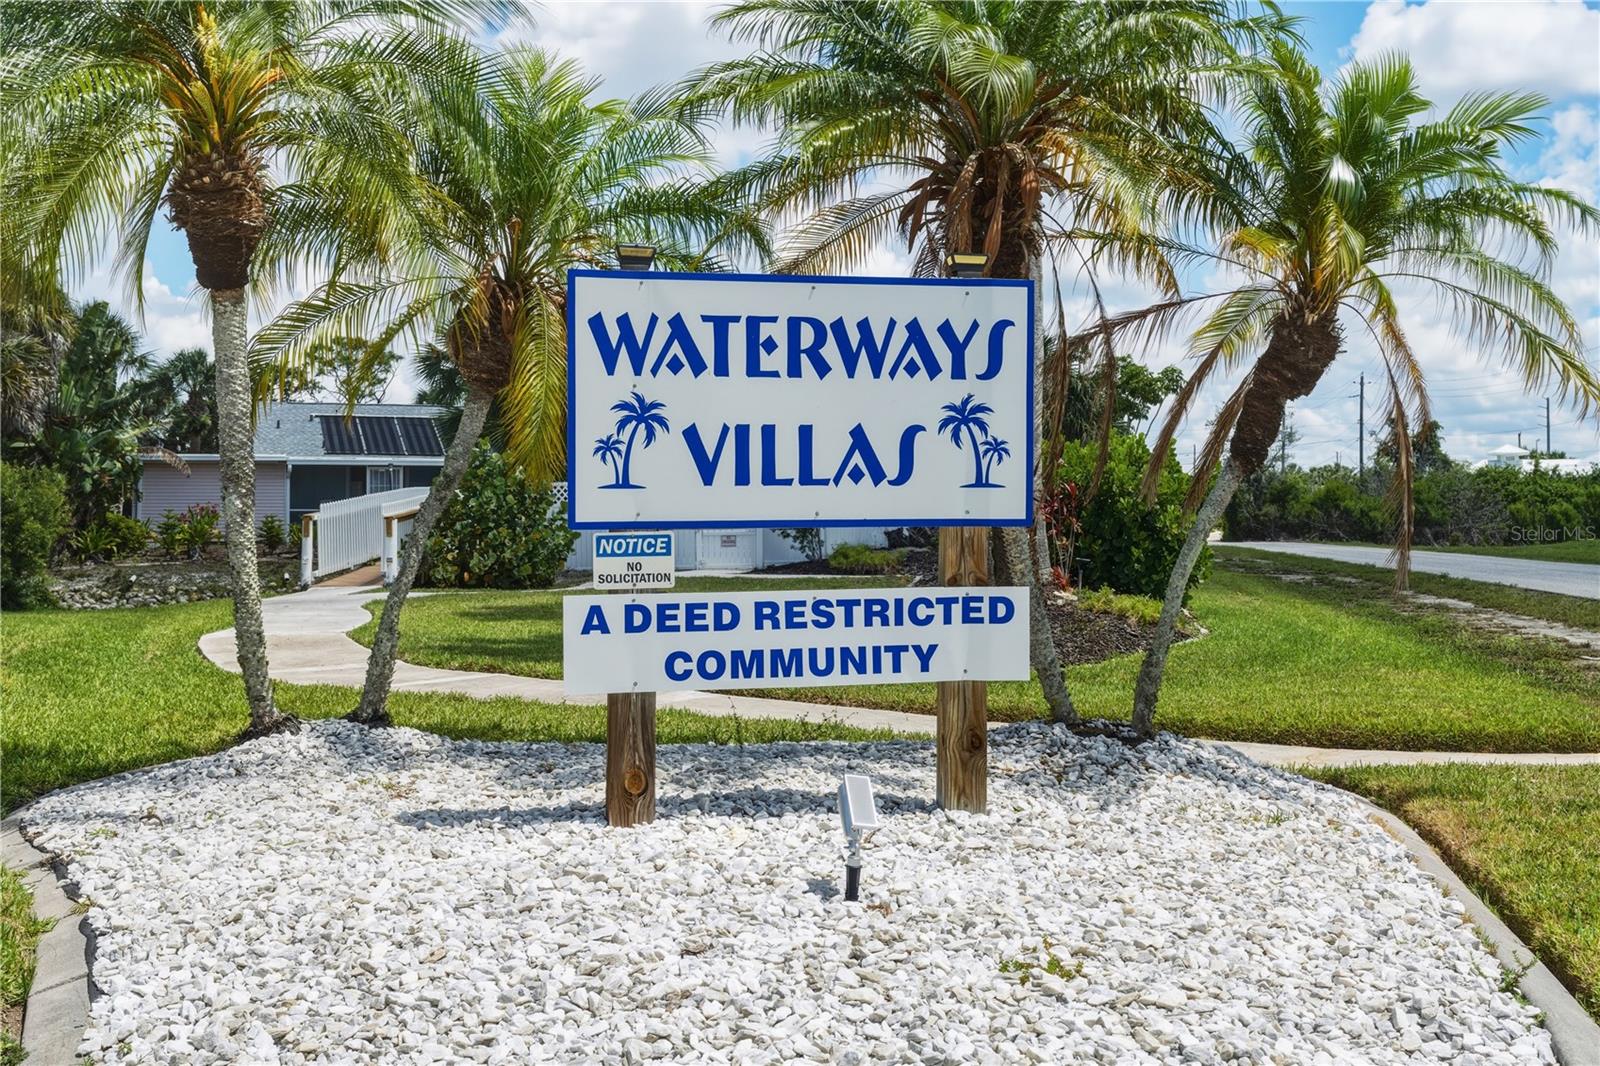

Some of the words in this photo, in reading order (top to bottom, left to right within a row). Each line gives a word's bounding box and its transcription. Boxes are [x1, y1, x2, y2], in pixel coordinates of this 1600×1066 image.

[587, 311, 1016, 381] WATERWAYS
[681, 422, 928, 488] VILLAS
[599, 538, 668, 554] NOTICE
[598, 573, 671, 584] SOLICITATION
[626, 561, 643, 572] NO
[580, 604, 611, 635] A
[624, 601, 741, 634] DEED
[754, 596, 1015, 630] RESTRICTED
[664, 643, 940, 682] COMMUNITY
